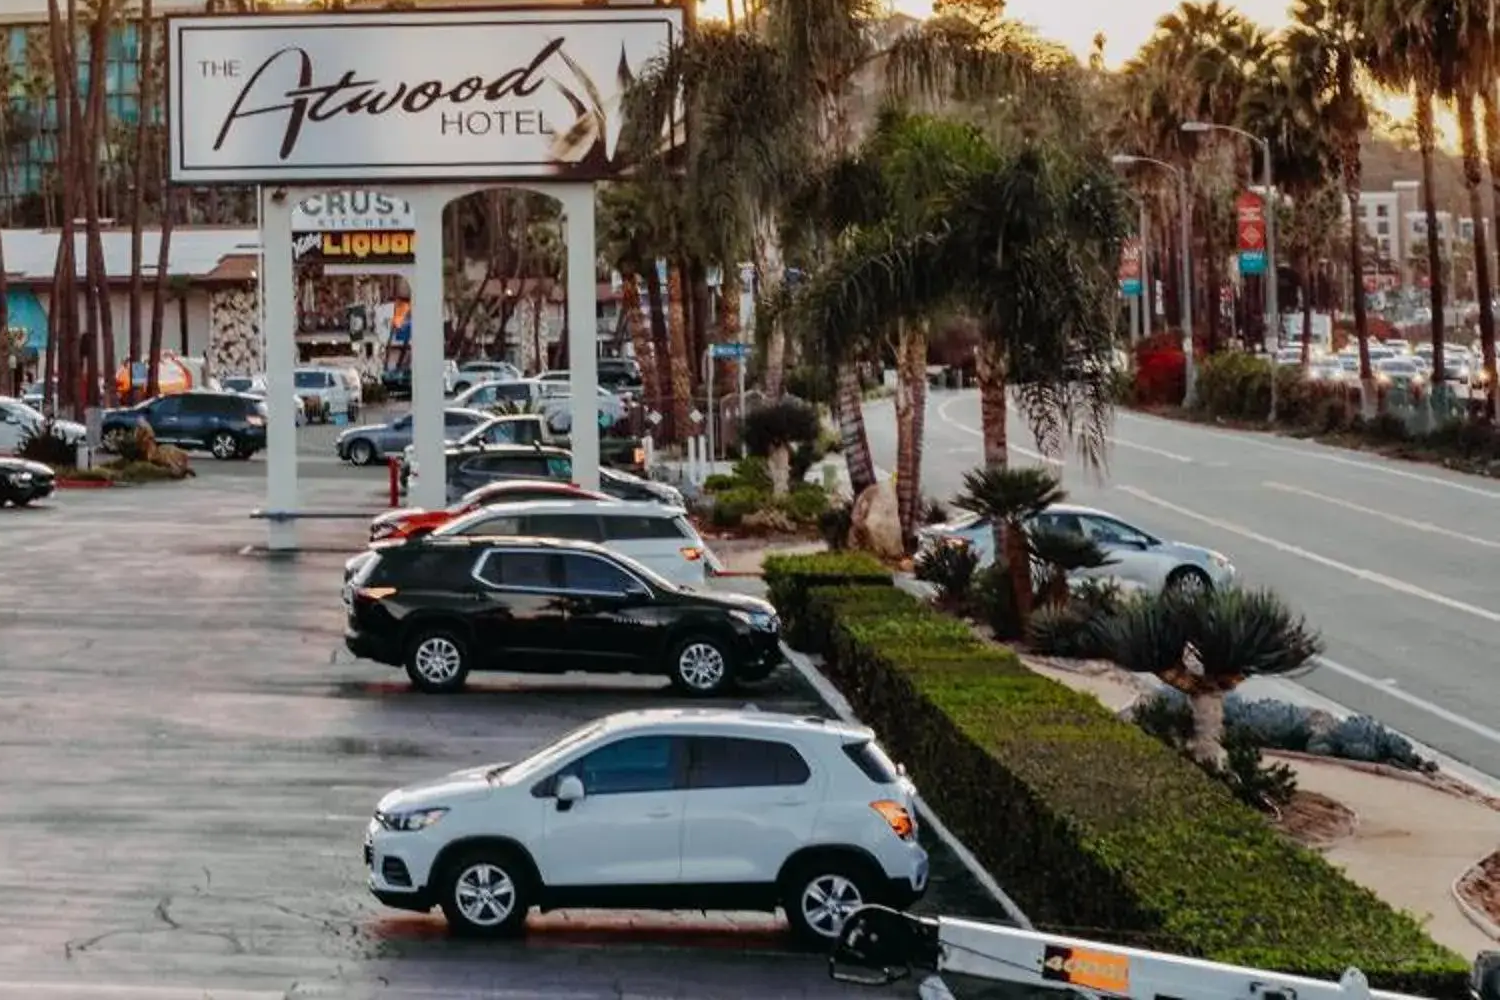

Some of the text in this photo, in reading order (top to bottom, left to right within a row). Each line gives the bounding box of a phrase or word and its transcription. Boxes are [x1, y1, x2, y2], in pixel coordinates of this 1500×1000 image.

[199, 59, 242, 78] THE
[212, 36, 566, 160] Atwood
[440, 110, 554, 136] HOTEL
[323, 231, 415, 258] LIQUO
